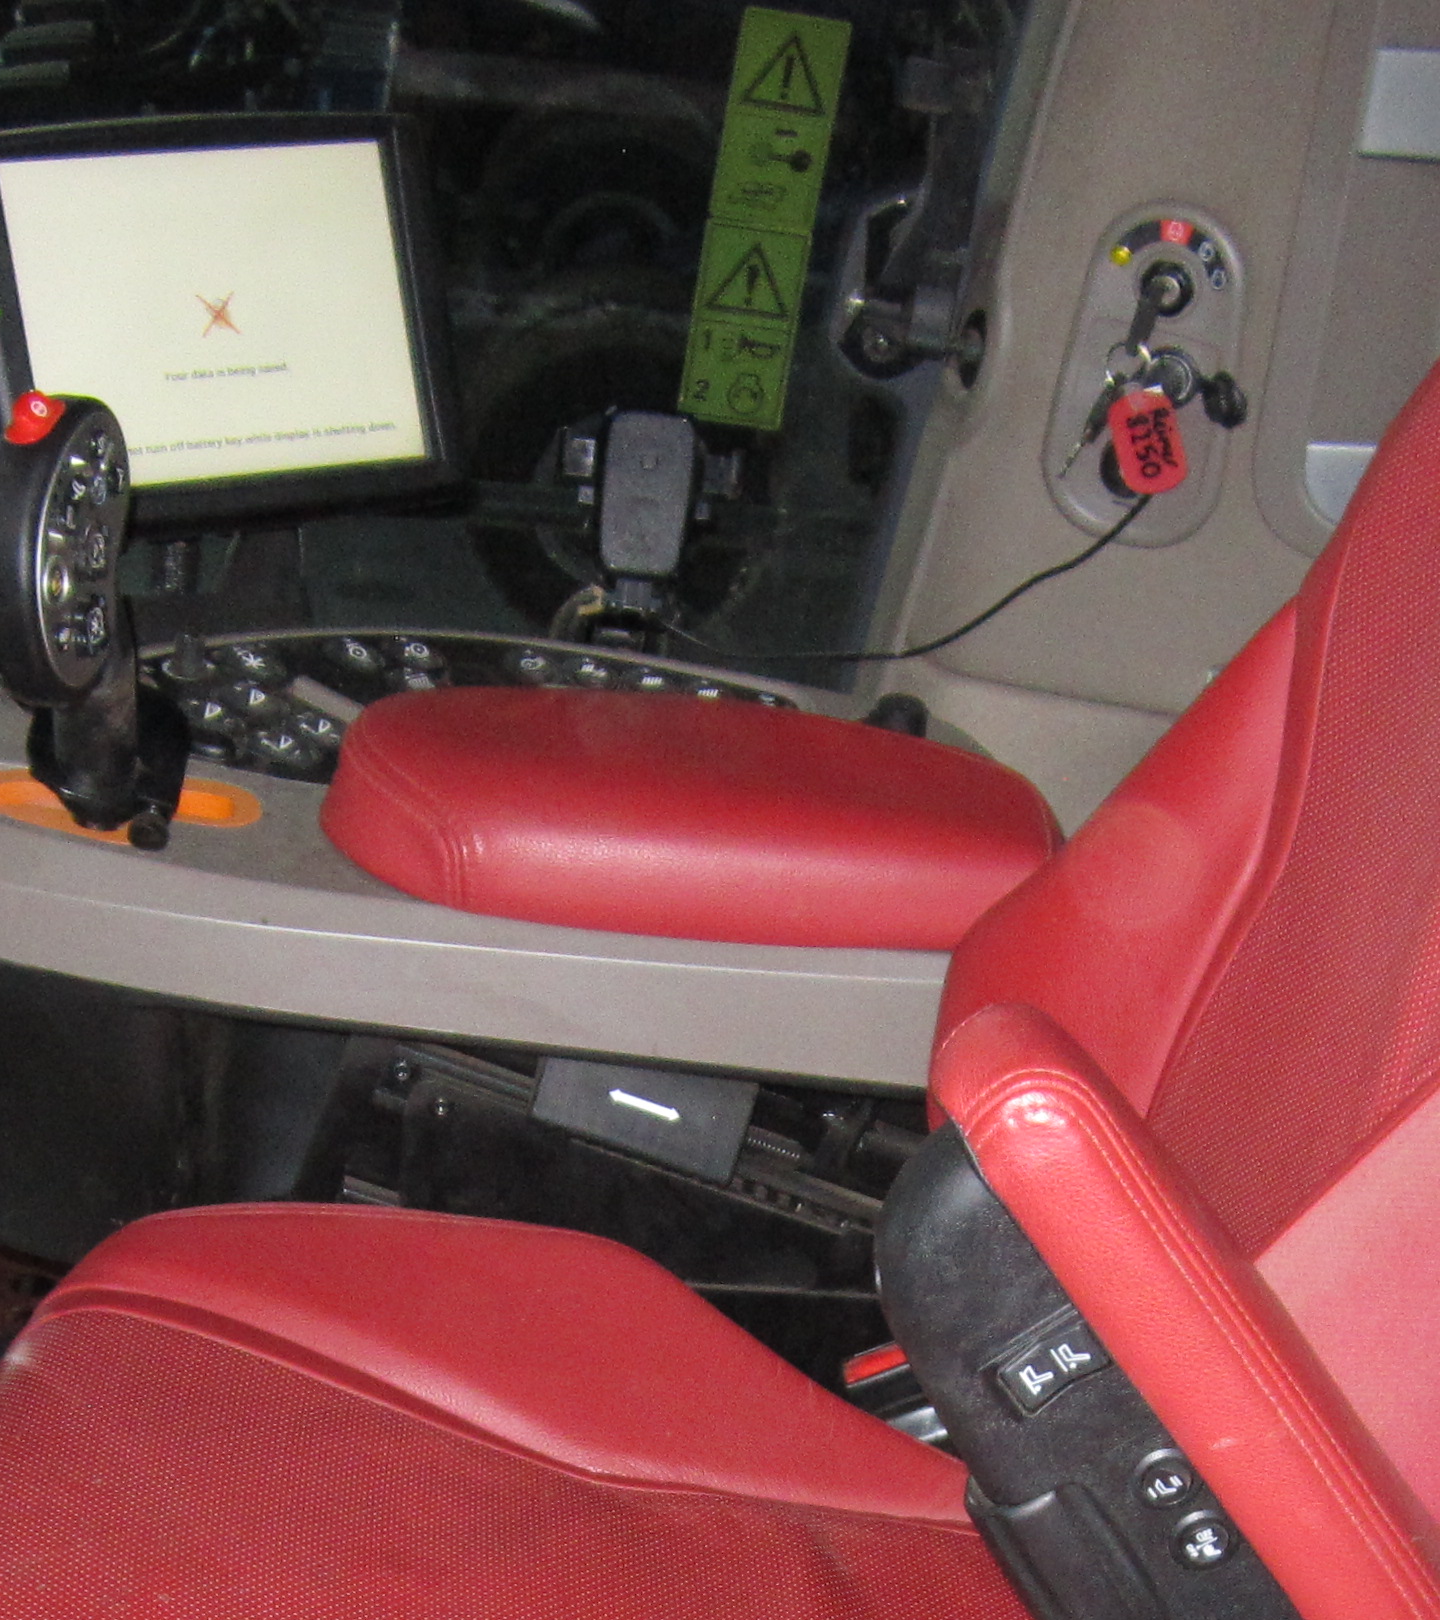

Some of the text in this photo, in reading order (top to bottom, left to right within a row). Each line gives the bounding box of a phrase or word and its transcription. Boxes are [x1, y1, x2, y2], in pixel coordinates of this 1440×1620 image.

[191, 368, 214, 379] data
[227, 365, 256, 378] being
[146, 444, 168, 454] turn
[170, 441, 184, 451] off
[185, 439, 222, 450] battery
[223, 436, 242, 447] key
[244, 432, 272, 443] while
[274, 428, 309, 441] display
[323, 424, 366, 436] shutting
